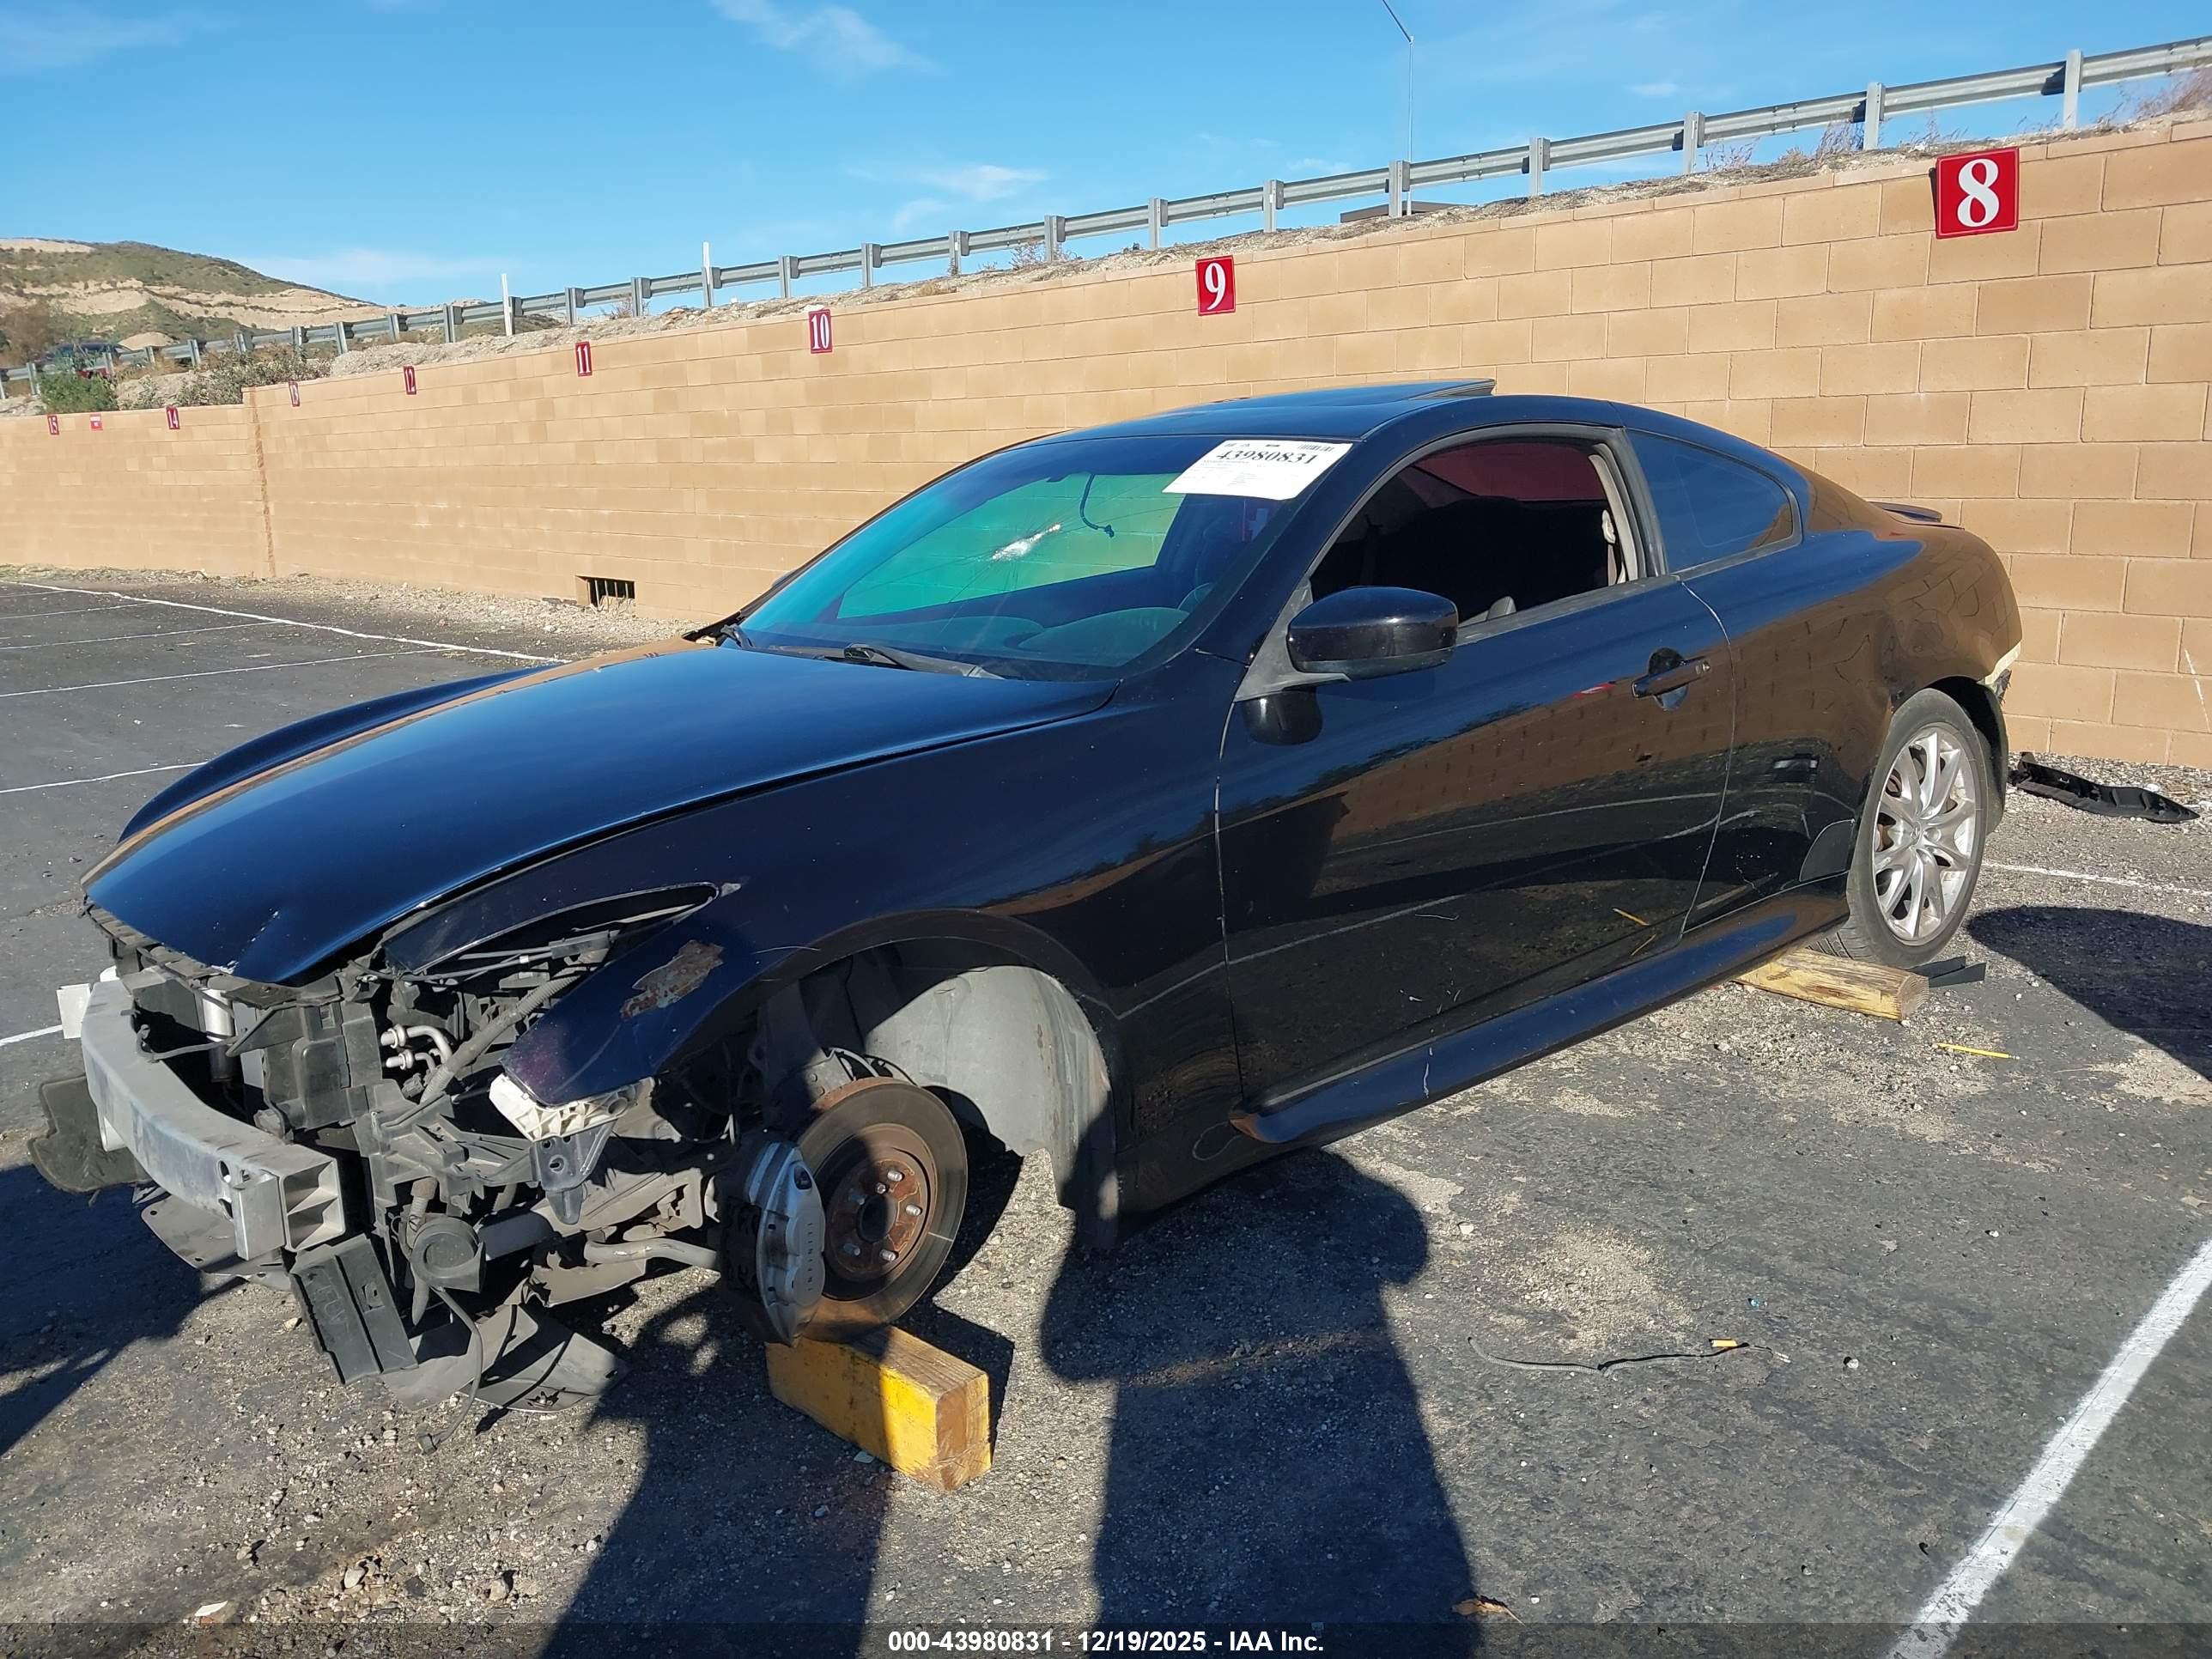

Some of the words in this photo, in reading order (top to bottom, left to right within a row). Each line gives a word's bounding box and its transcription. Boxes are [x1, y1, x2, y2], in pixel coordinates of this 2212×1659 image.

[1957, 158, 2000, 228] 8
[1205, 262, 1226, 311] 9
[811, 313, 830, 349] 10
[576, 345, 591, 374] 11
[404, 368, 416, 392] 12
[167, 409, 179, 428] 14
[1216, 450, 1318, 465] 43980831
